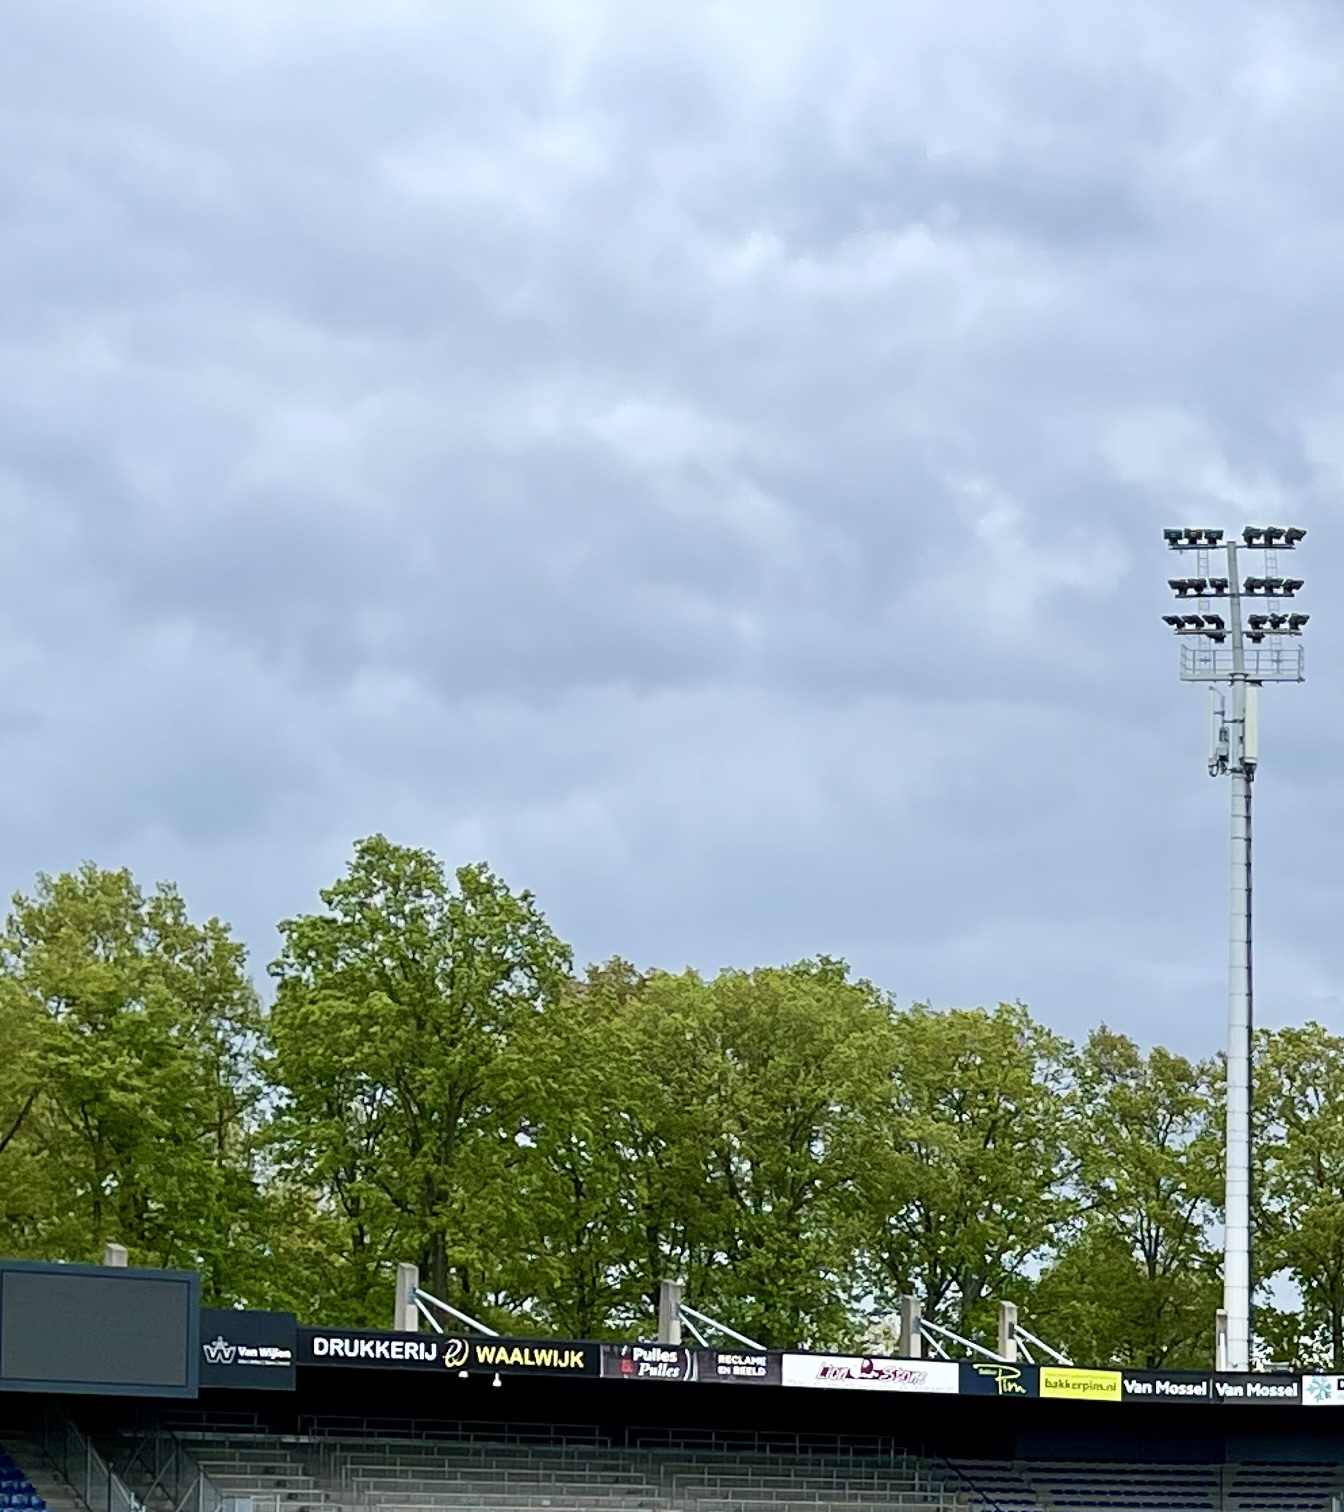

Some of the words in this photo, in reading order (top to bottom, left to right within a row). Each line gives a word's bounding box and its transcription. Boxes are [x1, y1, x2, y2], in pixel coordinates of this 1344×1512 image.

[313, 1336, 437, 1361] DRUKKERIJ
[475, 1345, 585, 1369] WAALWIJK
[632, 1347, 678, 1363] Pulles
[637, 1362, 681, 1378] Pulles
[1123, 1379, 1152, 1395] Van
[1155, 1380, 1207, 1397] Mossel
[1215, 1381, 1246, 1396] Van
[1248, 1381, 1299, 1398] Mossel
